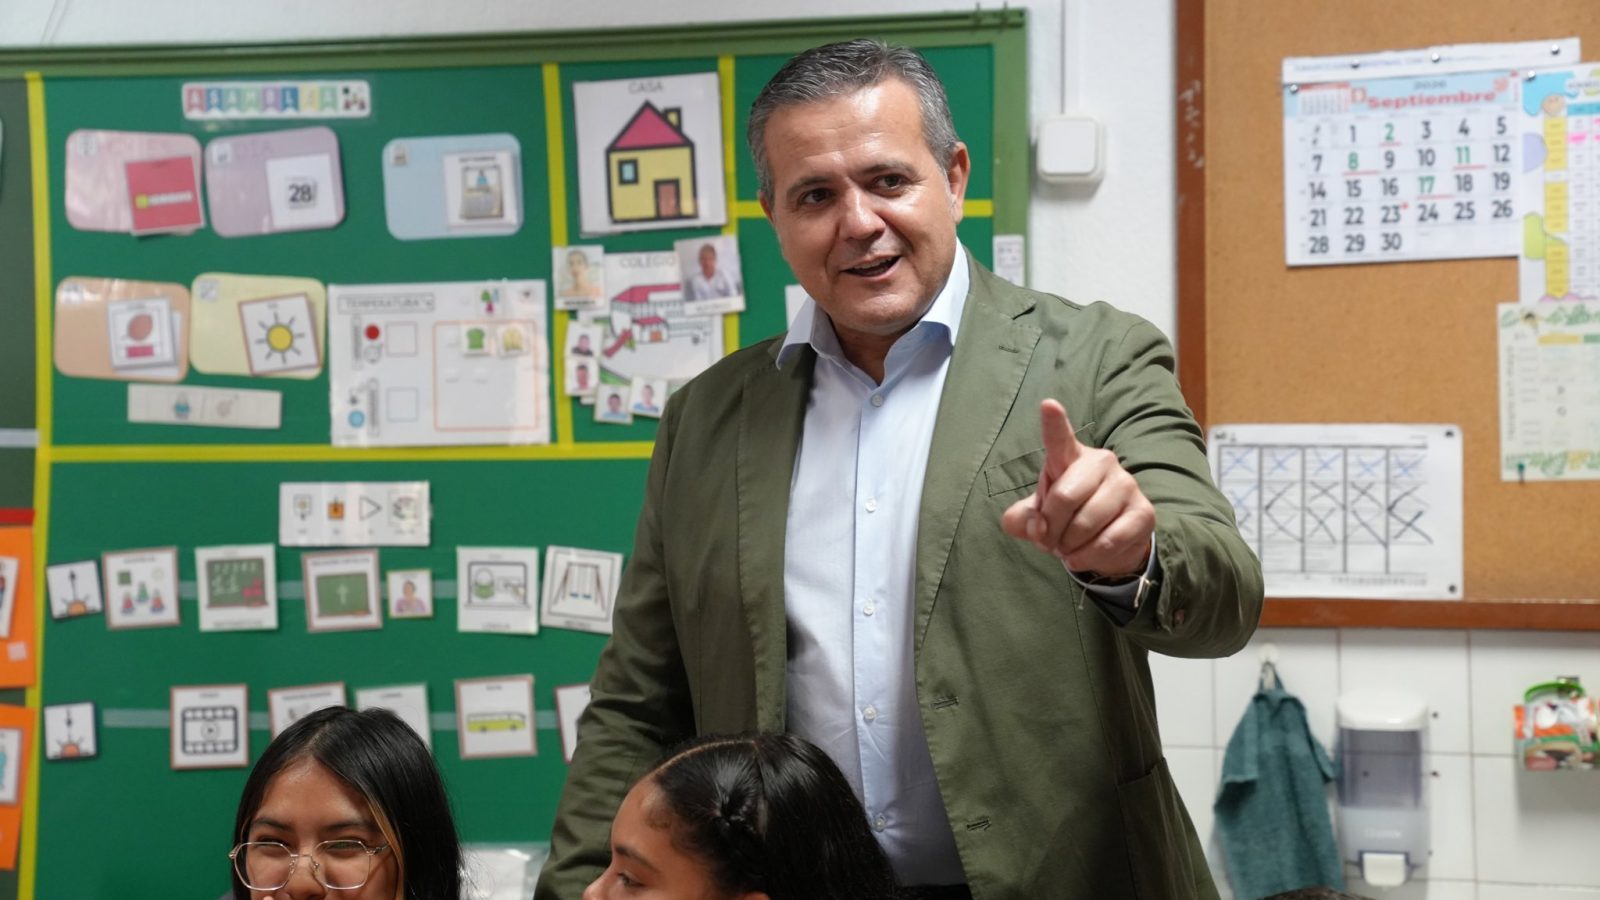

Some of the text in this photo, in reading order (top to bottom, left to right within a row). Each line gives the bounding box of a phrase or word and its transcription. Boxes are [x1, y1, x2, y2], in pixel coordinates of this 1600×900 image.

[628, 79, 665, 95] CASA
[1367, 91, 1496, 110] Septiembre
[1349, 115, 1507, 143] 1 2 3 4 5
[1312, 143, 1511, 173] 7 8 9 10 11 12
[288, 183, 312, 203] 28
[1309, 171, 1511, 200] 14 15 16 17 18 19
[1309, 199, 1513, 227] 21 22 23 24 25 26
[1309, 231, 1403, 254] 28 29 30
[619, 253, 679, 269] COLEGIO
